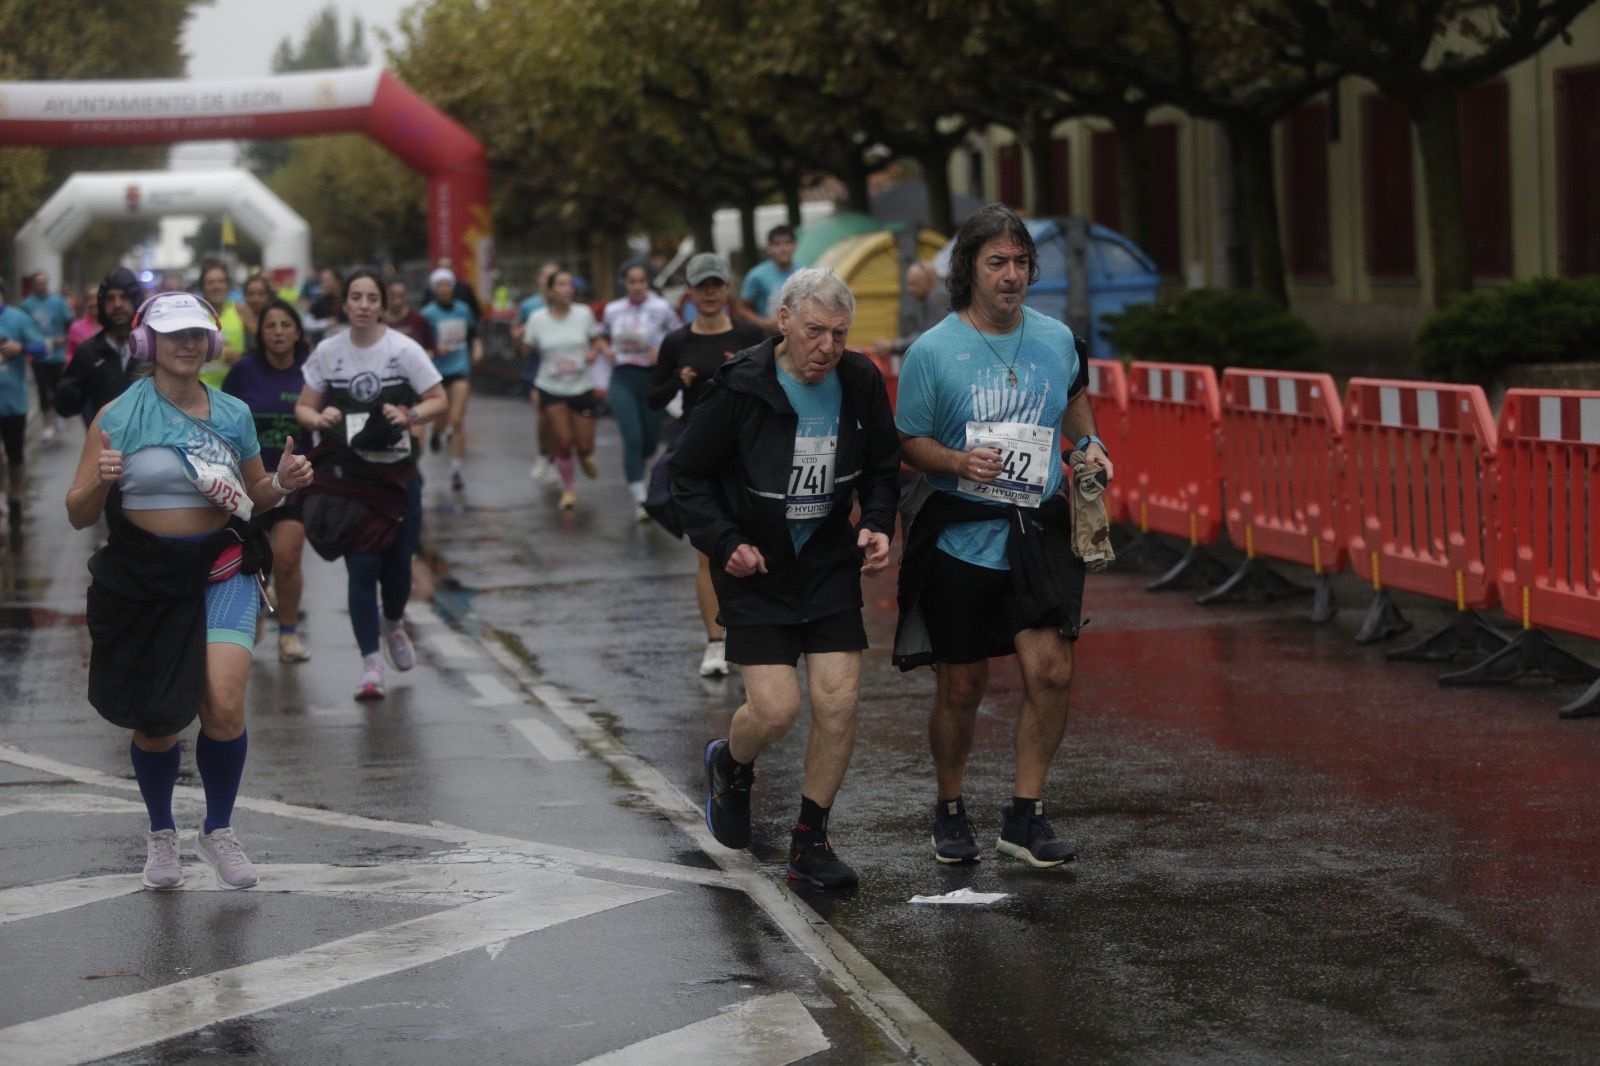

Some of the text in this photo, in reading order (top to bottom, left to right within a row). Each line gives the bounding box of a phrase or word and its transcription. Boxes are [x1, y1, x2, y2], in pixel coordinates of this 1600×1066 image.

[43, 94, 198, 114] AYUNTAMIENTO
[201, 92, 225, 110] DE
[791, 465, 826, 494] 741
[991, 487, 1030, 501] HYUNDAI
